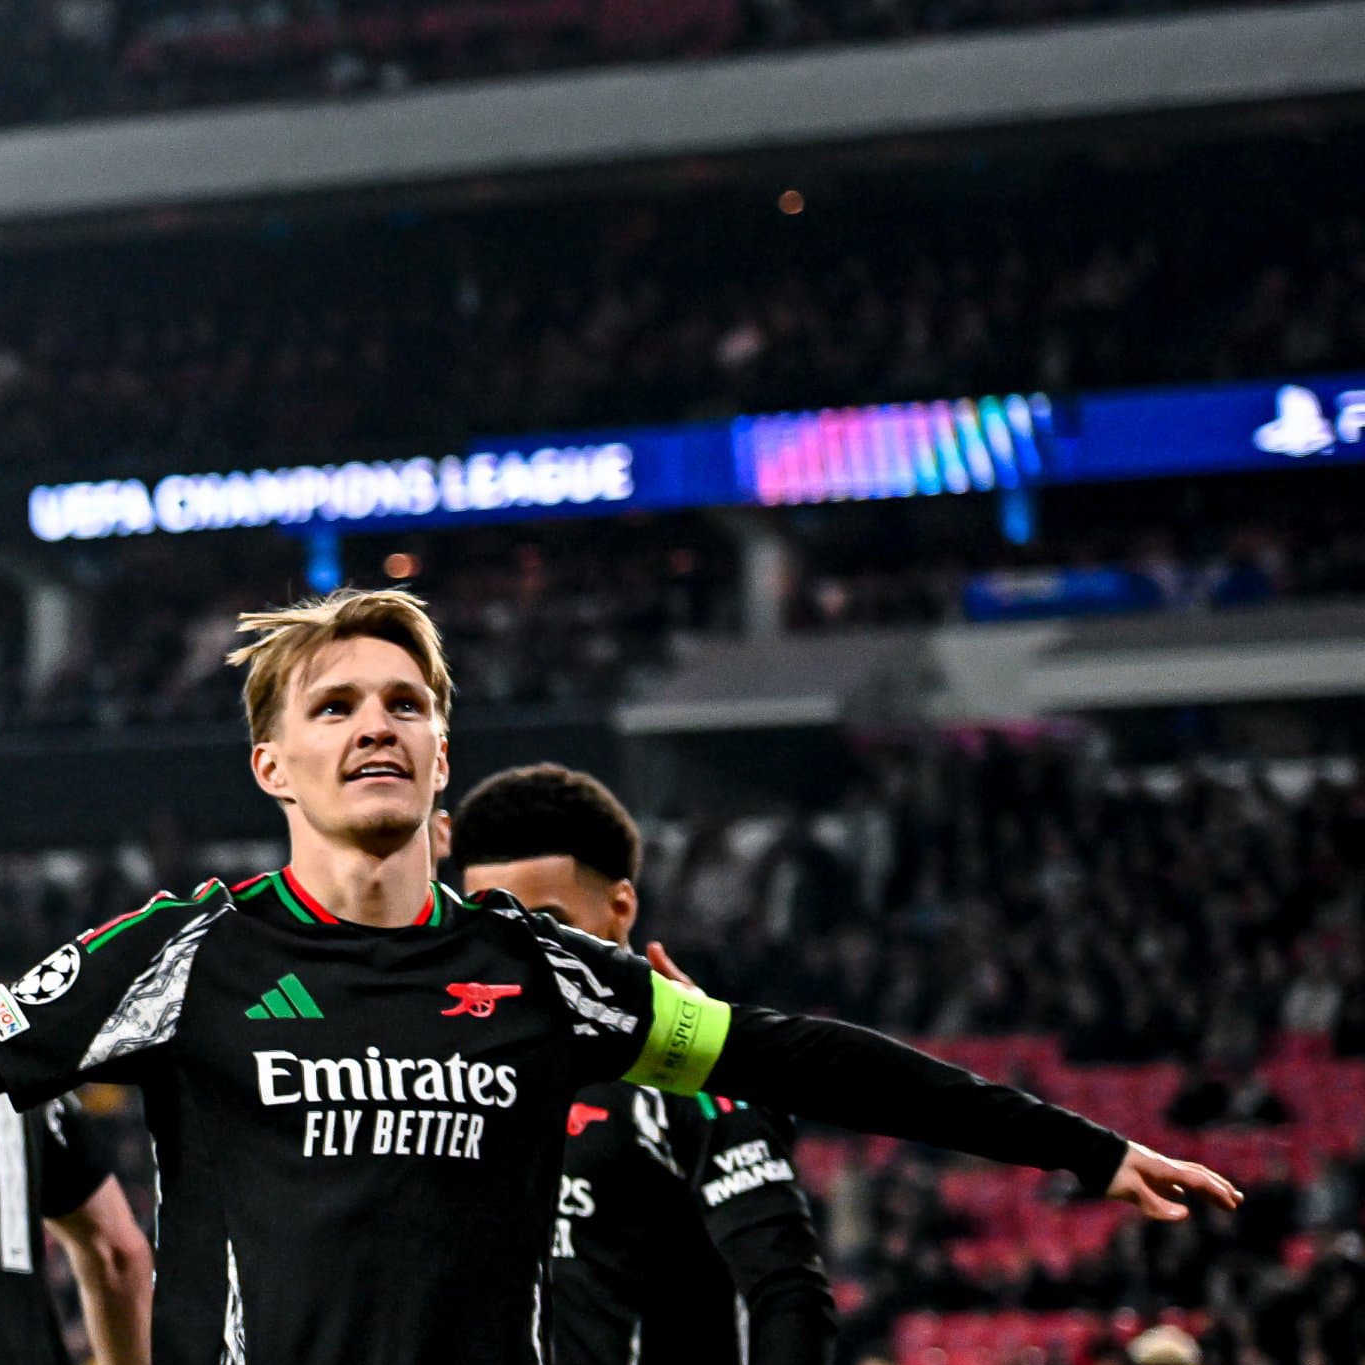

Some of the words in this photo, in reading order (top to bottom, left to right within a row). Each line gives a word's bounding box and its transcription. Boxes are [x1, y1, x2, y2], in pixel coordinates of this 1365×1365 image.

[153, 457, 436, 533] CHAMPIONS
[438, 442, 634, 513] LEAGUE
[252, 1046, 518, 1108] Emirates
[303, 1110, 363, 1158] FLY
[373, 1110, 485, 1160] BETTER
[713, 1139, 771, 1174] VISIT
